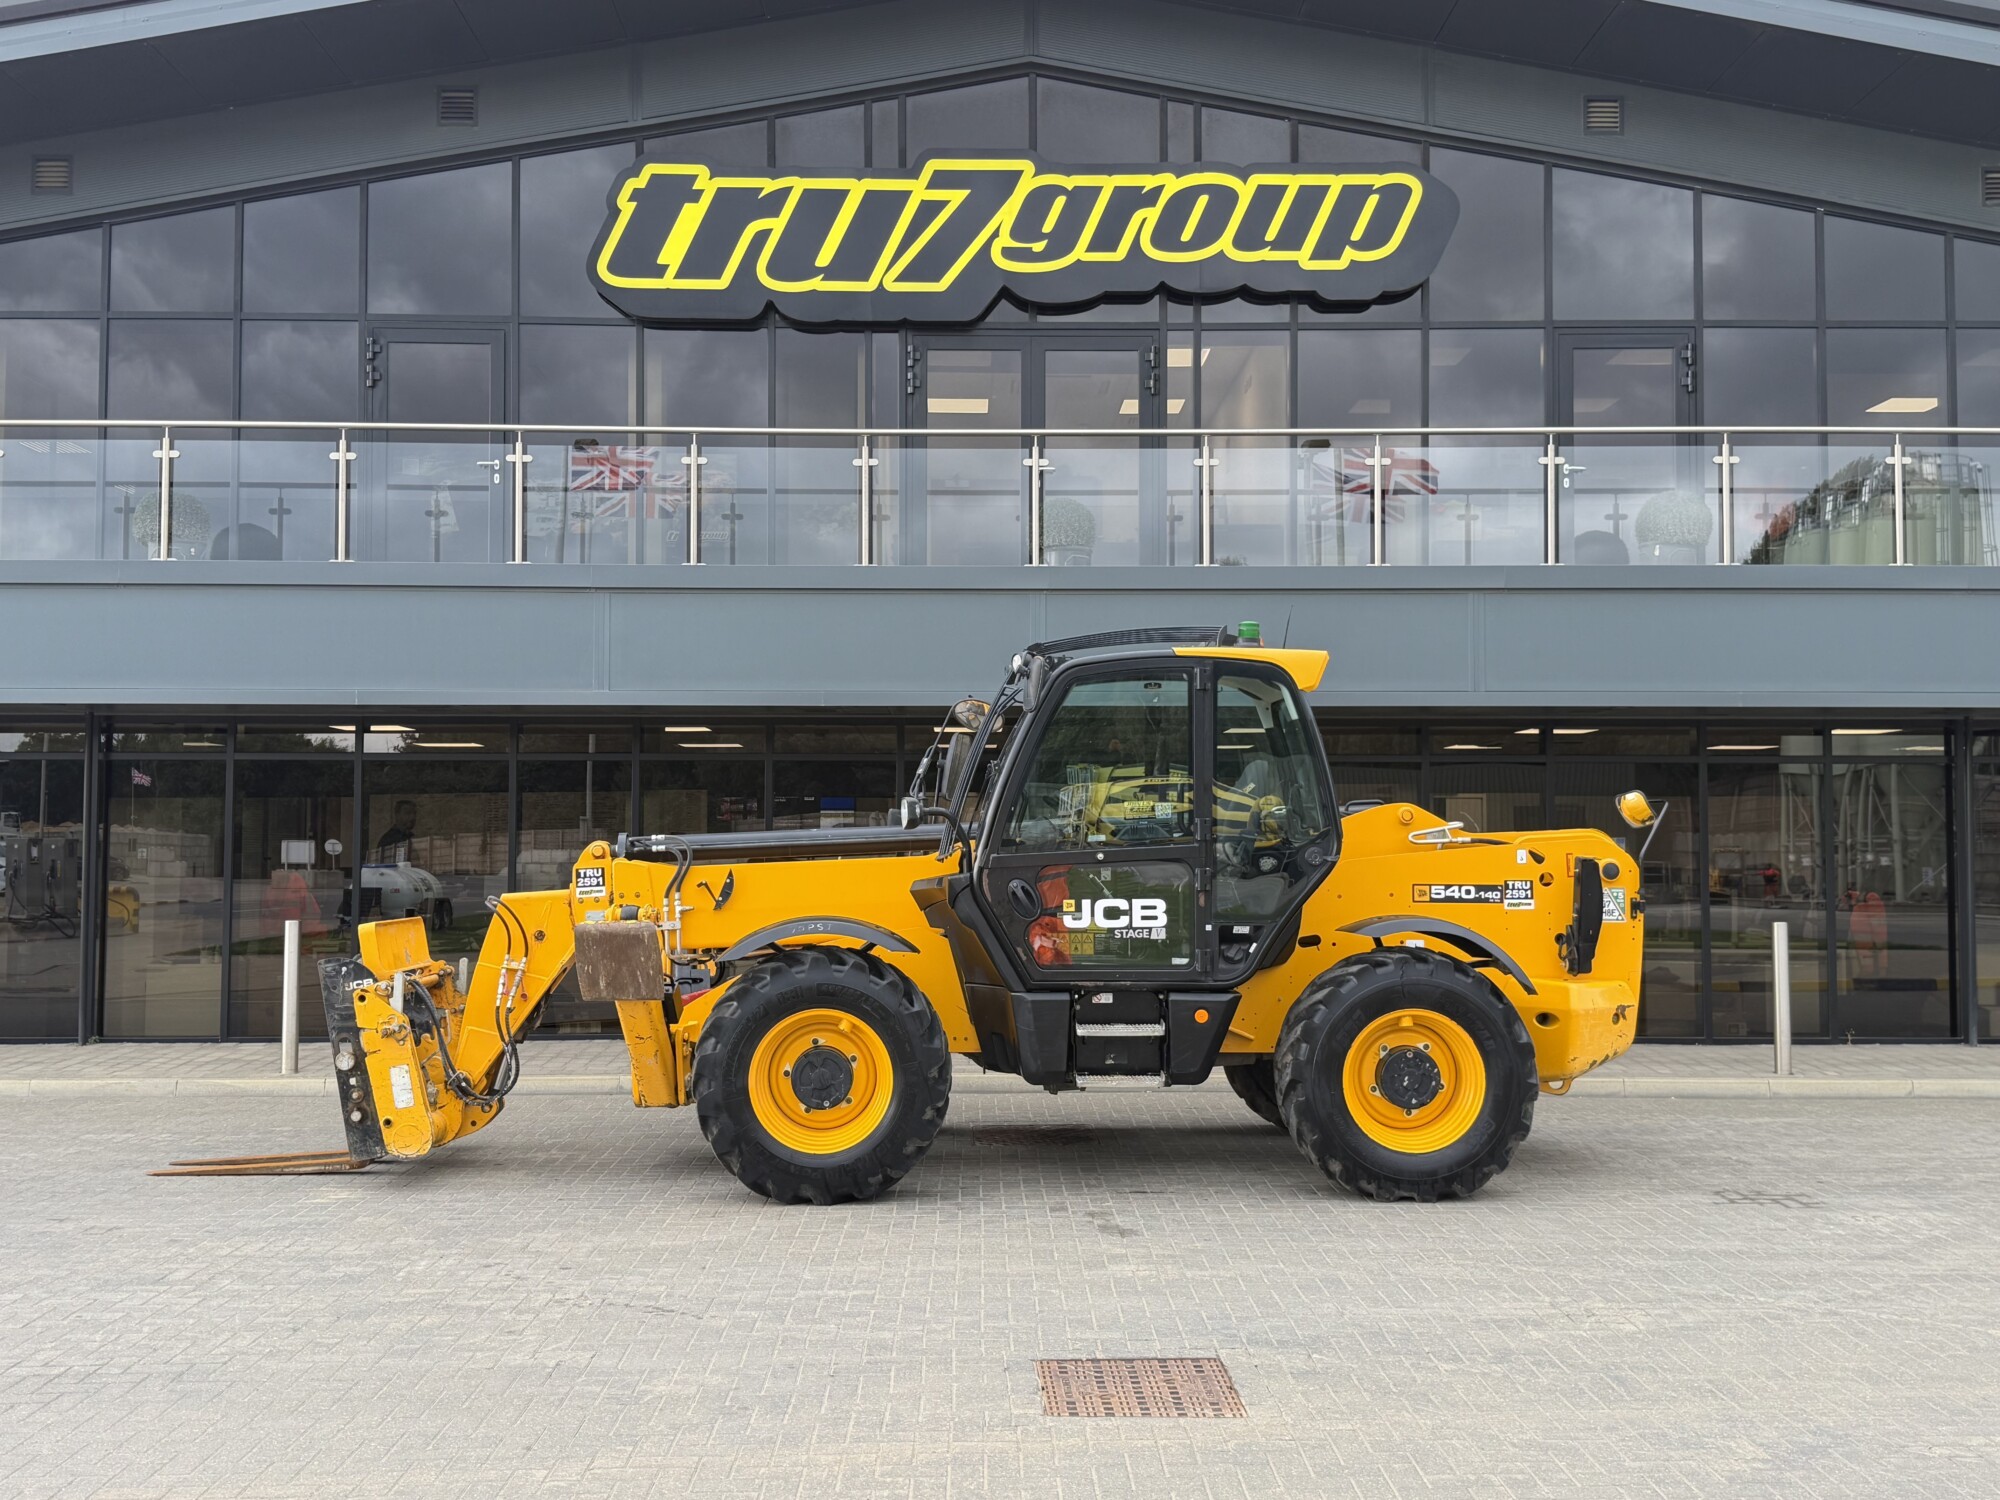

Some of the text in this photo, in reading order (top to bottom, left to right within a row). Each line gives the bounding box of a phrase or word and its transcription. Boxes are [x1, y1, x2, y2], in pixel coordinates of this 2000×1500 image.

[578, 868, 602, 878] TRU
[577, 877, 603, 887] 2591
[1506, 881, 1531, 890] TRU
[1430, 885, 1501, 899] 540-140
[1505, 889, 1532, 899] 2591
[1062, 898, 1168, 929] JCB
[1114, 929, 1150, 939] STAGE
